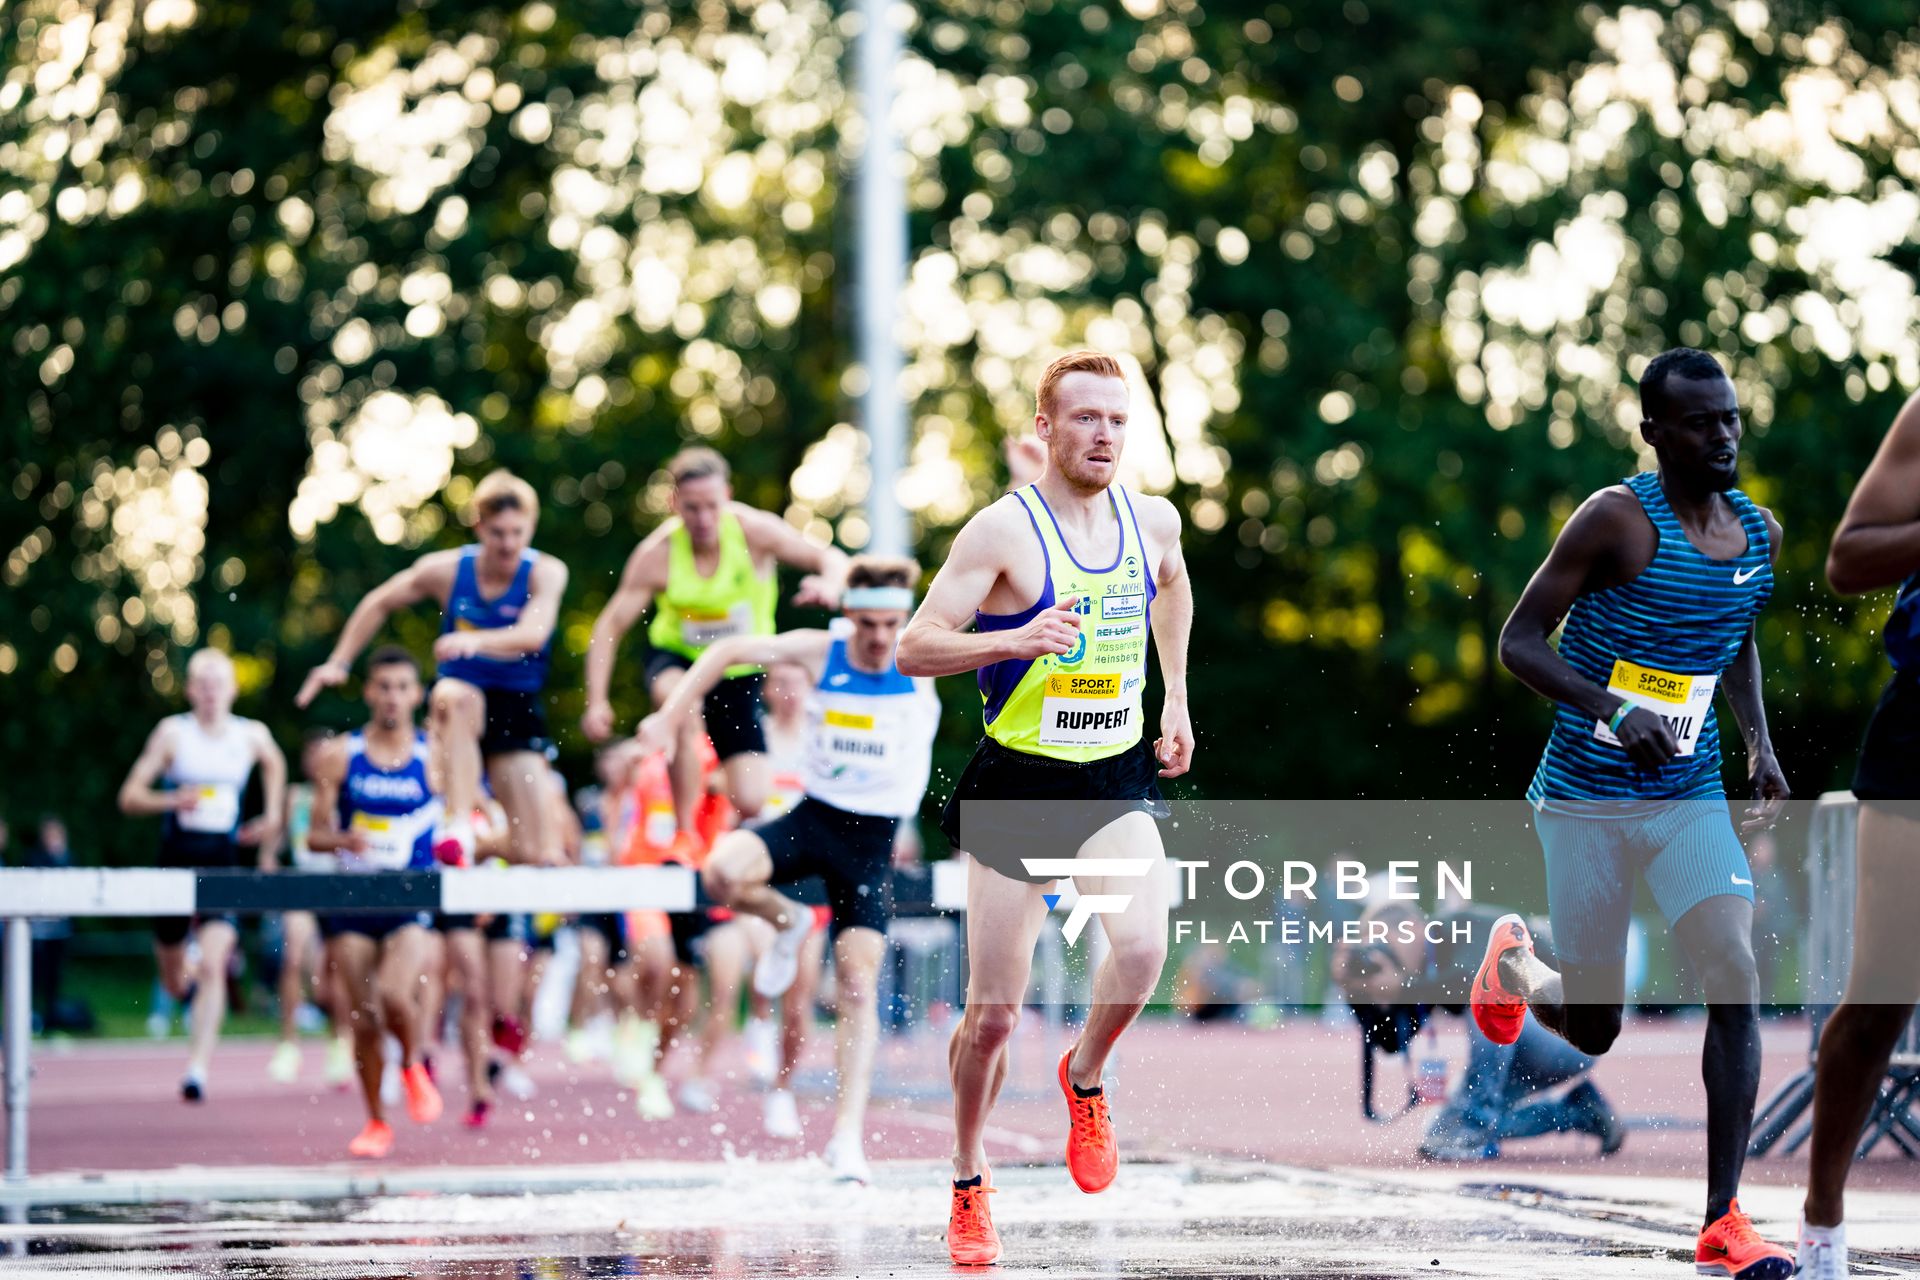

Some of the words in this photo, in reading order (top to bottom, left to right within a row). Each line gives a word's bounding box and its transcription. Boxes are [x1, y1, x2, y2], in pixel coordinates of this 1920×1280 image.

[1106, 584, 1118, 595] SC
[1120, 582, 1143, 594] MYHL
[1094, 653, 1139, 664] Heinsberg
[1071, 678, 1115, 689] SPORT.
[1056, 707, 1130, 730] RUPPERT
[1660, 714, 1693, 740] AIL
